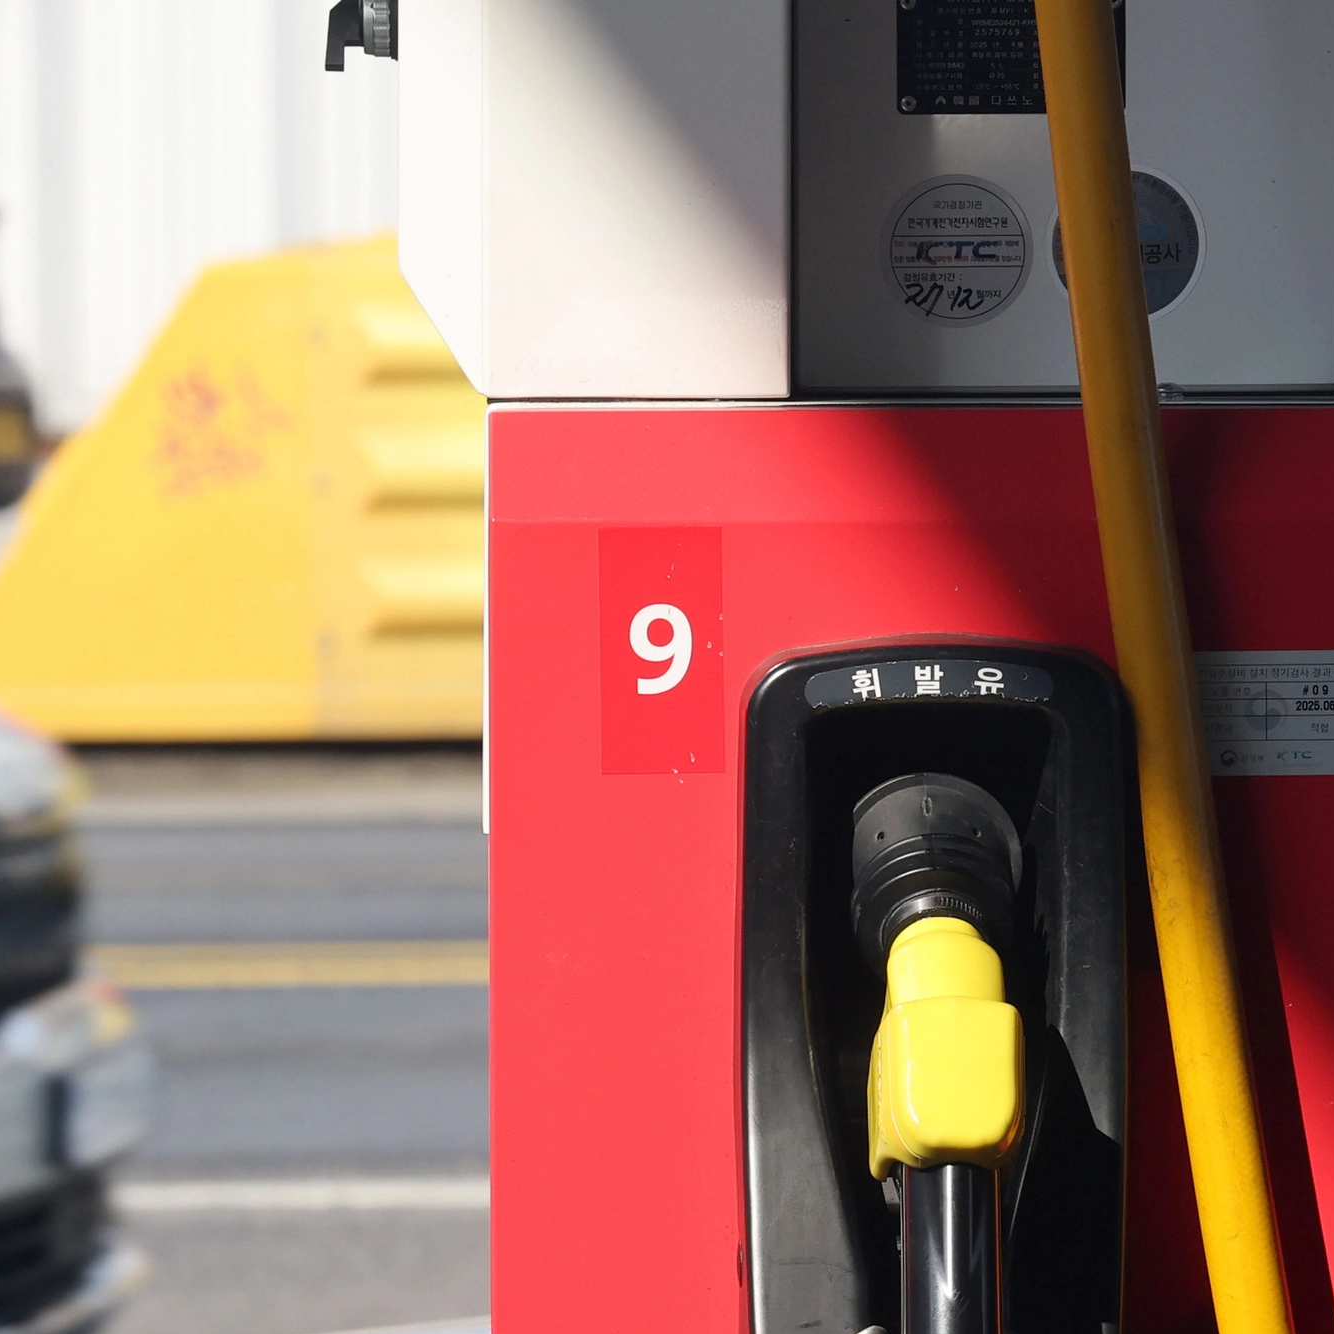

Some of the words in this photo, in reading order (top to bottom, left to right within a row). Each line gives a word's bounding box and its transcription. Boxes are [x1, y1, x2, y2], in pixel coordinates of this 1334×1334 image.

[933, 200, 982, 210] 국가검정기관
[907, 217, 1008, 229] 한국기계전기전자시험연구원
[916, 241, 1000, 265] KTC
[1141, 243, 1181, 264] 공사
[903, 273, 955, 282] 검정유효기간
[905, 282, 943, 316] 27
[951, 286, 983, 311] 12
[628, 603, 693, 696] 9
[1271, 667, 1309, 677] 정기검사
[1312, 667, 1331, 677] 결과
[1310, 723, 1329, 732] 적합
[1277, 751, 1312, 760] KTC
